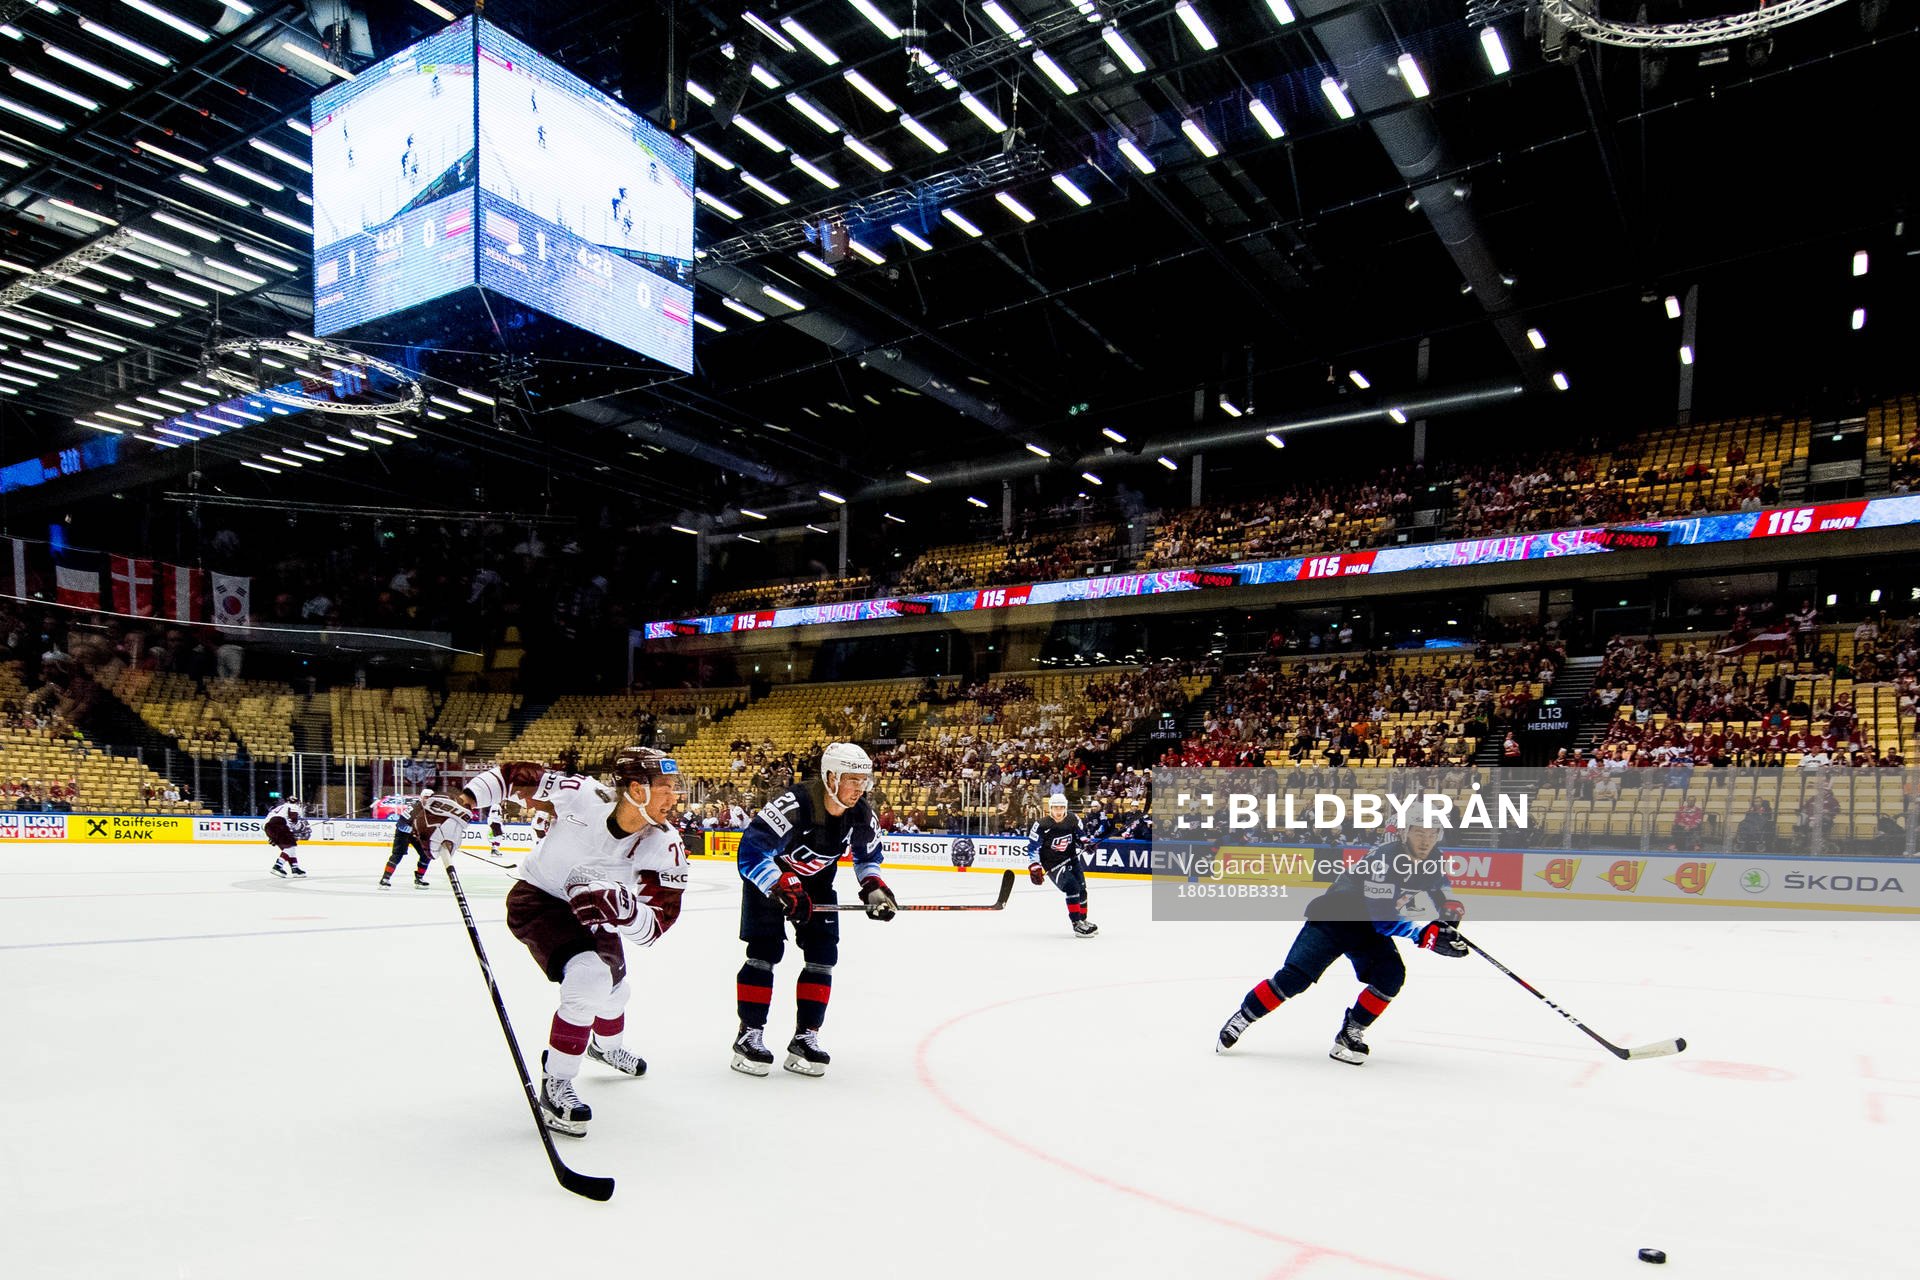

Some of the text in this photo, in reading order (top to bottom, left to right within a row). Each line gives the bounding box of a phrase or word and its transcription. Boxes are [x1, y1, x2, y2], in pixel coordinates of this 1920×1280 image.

[423, 218, 435, 248] 0
[535, 231, 546, 261] 1
[636, 281, 651, 309] 0
[1767, 508, 1857, 535] 115 KM/H
[1308, 556, 1370, 578] 115 KM/H
[981, 589, 1006, 608] 115
[737, 614, 757, 630] 115
[1539, 708, 1562, 719] L13
[1158, 719, 1176, 730] L12
[25, 816, 64, 827] LIQUI
[114, 816, 178, 827] Raiffeisen
[223, 822, 265, 832] TISS
[25, 827, 64, 838] MOLY
[115, 830, 153, 839] BANK
[900, 842, 948, 854] TISSOT
[1129, 850, 1186, 870] MEN
[1470, 880, 1502, 888] PARTS
[1784, 870, 1904, 893] ŠKODA
